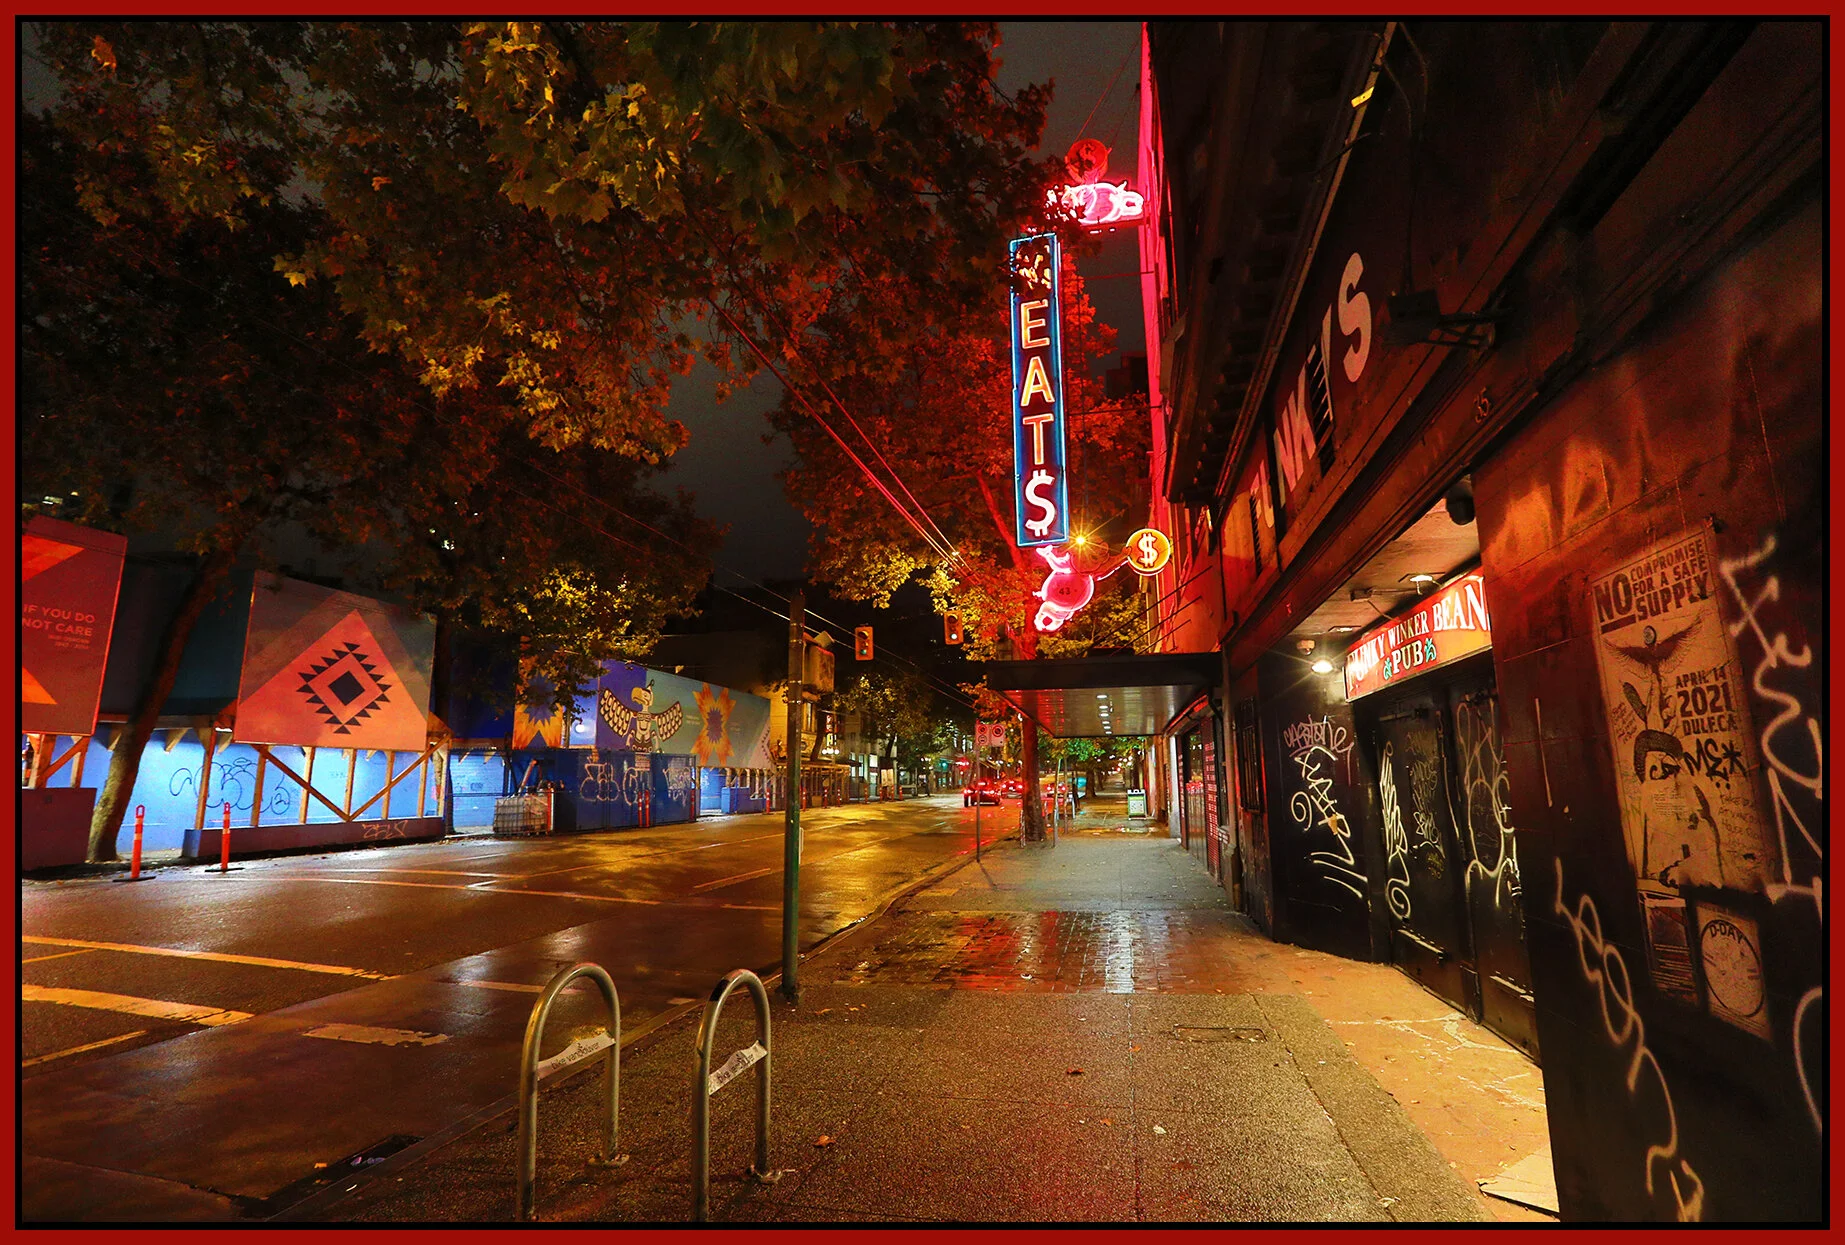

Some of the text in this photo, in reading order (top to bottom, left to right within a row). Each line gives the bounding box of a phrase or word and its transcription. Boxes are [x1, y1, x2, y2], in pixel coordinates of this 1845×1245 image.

[1630, 539, 1704, 582] COMPROMISE
[1632, 555, 1707, 597] FOR A SAFE
[23, 603, 95, 623] IF YOU DO
[1387, 610, 1430, 650] WINKER
[1432, 576, 1491, 632] BEAN
[1594, 573, 1633, 623] NO
[1636, 572, 1709, 620] SUPPLY
[22, 617, 94, 637] NOT CARE
[1391, 640, 1424, 674] PUB
[1676, 670, 1709, 689] APRIL
[1677, 682, 1735, 717] 2021
[1709, 922, 1745, 944] D-DAY
